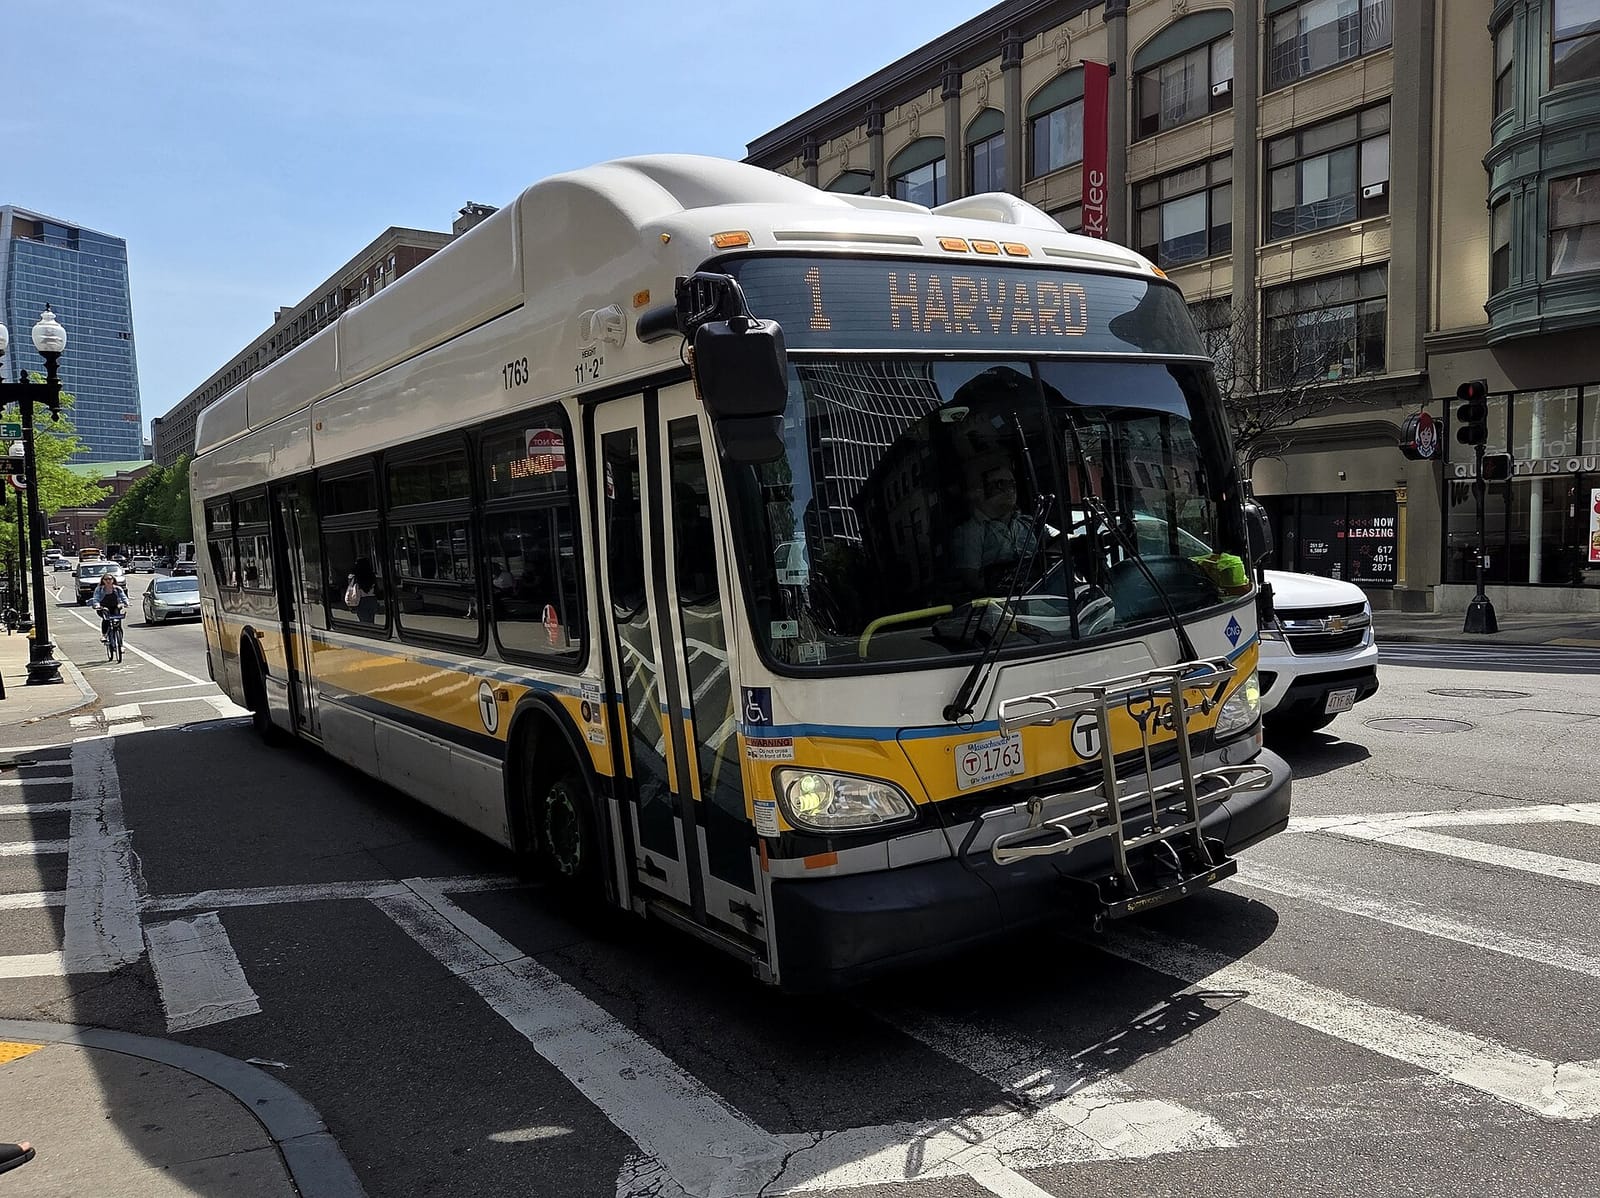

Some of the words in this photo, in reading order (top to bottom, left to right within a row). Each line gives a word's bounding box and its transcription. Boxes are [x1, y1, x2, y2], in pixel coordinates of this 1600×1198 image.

[804, 266, 831, 330] 1
[888, 272, 1088, 336] HARVARD
[502, 357, 529, 390] 1763
[491, 464, 498, 482] 1
[1454, 460, 1537, 478] QUTY
[1544, 459, 1560, 473] IS
[1373, 517, 1394, 527] NOW
[1349, 528, 1394, 538] LEASING
[1377, 545, 1393, 554] 617
[1372, 563, 1392, 572] 2871
[1226, 624, 1240, 636] CNG
[480, 693, 494, 726] T
[751, 738, 792, 747] WARNING!
[1076, 722, 1099, 752] T
[966, 757, 977, 771] T
[984, 743, 1021, 773] 1763
